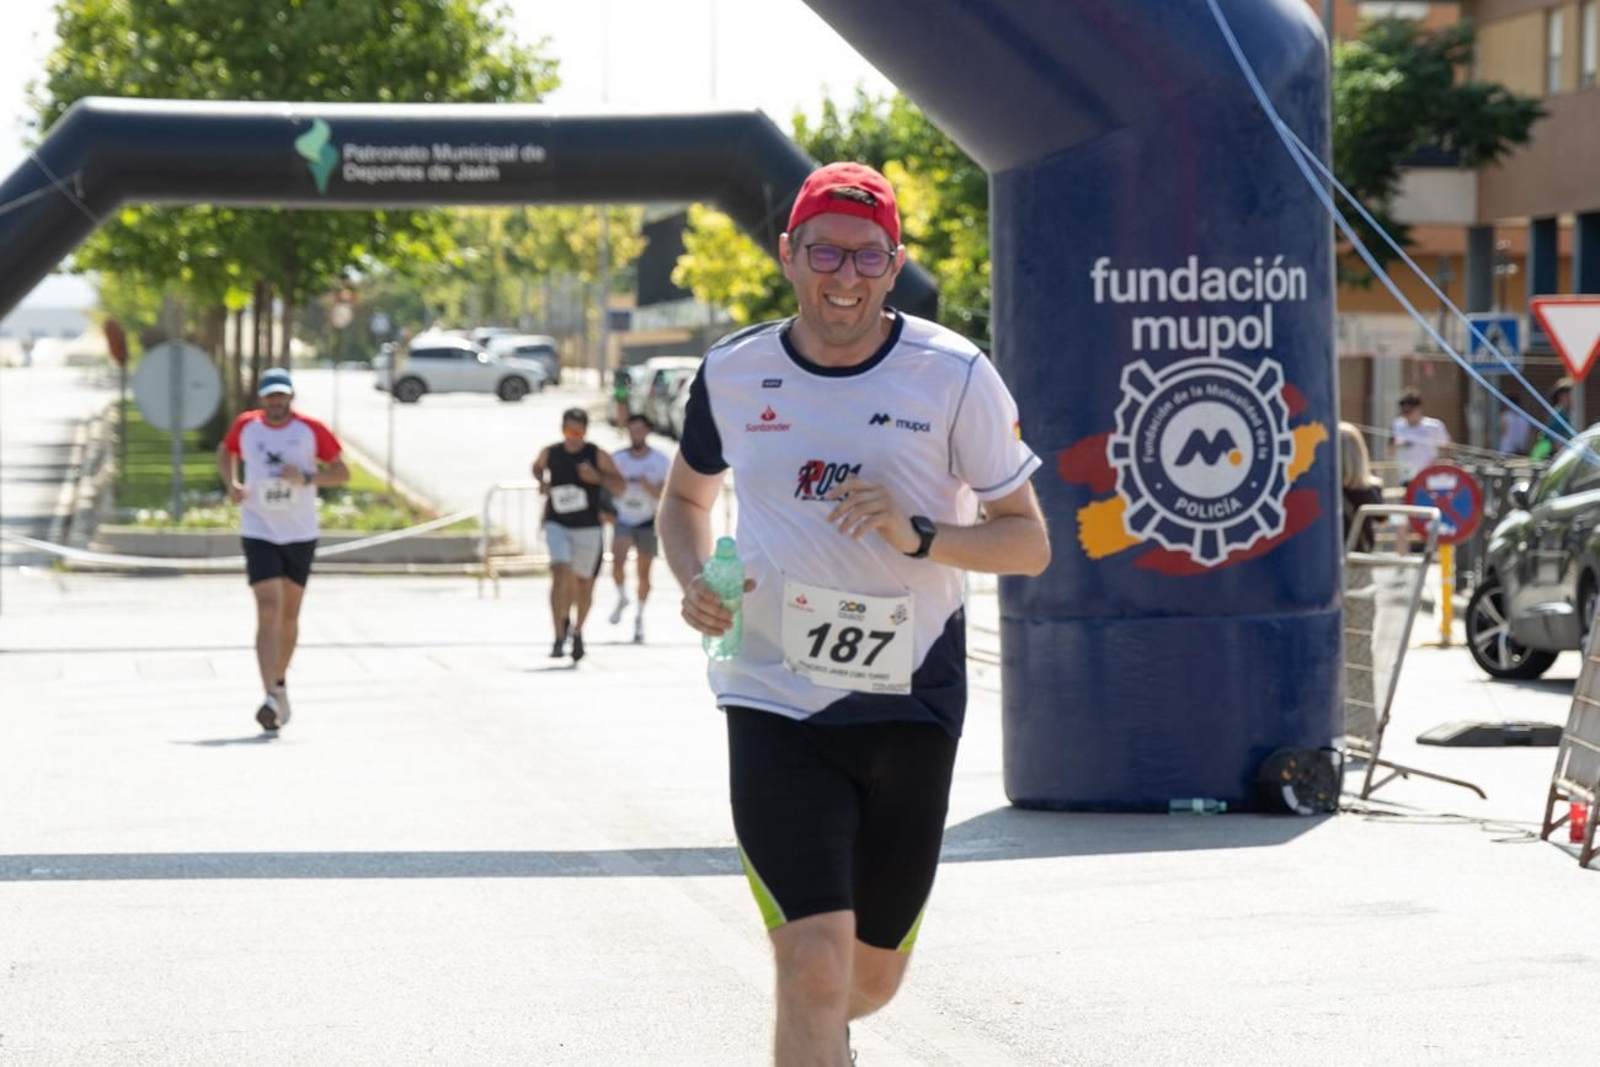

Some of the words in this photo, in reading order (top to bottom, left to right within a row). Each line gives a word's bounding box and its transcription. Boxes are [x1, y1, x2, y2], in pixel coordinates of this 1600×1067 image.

[432, 143, 518, 163] Municipal
[520, 145, 546, 163] de
[343, 162, 425, 184] Deportes
[427, 164, 453, 182] de
[1090, 255, 1308, 303] fundación
[1132, 303, 1273, 359] mupol
[895, 419, 931, 432] mupol
[1172, 390, 1189, 405] de
[1189, 384, 1204, 398] la
[1205, 383, 1263, 427] Mutualidad
[1255, 427, 1268, 445] de
[745, 423, 790, 432] Santander
[1174, 496, 1242, 519] POLICÍA
[807, 622, 896, 666] 187
